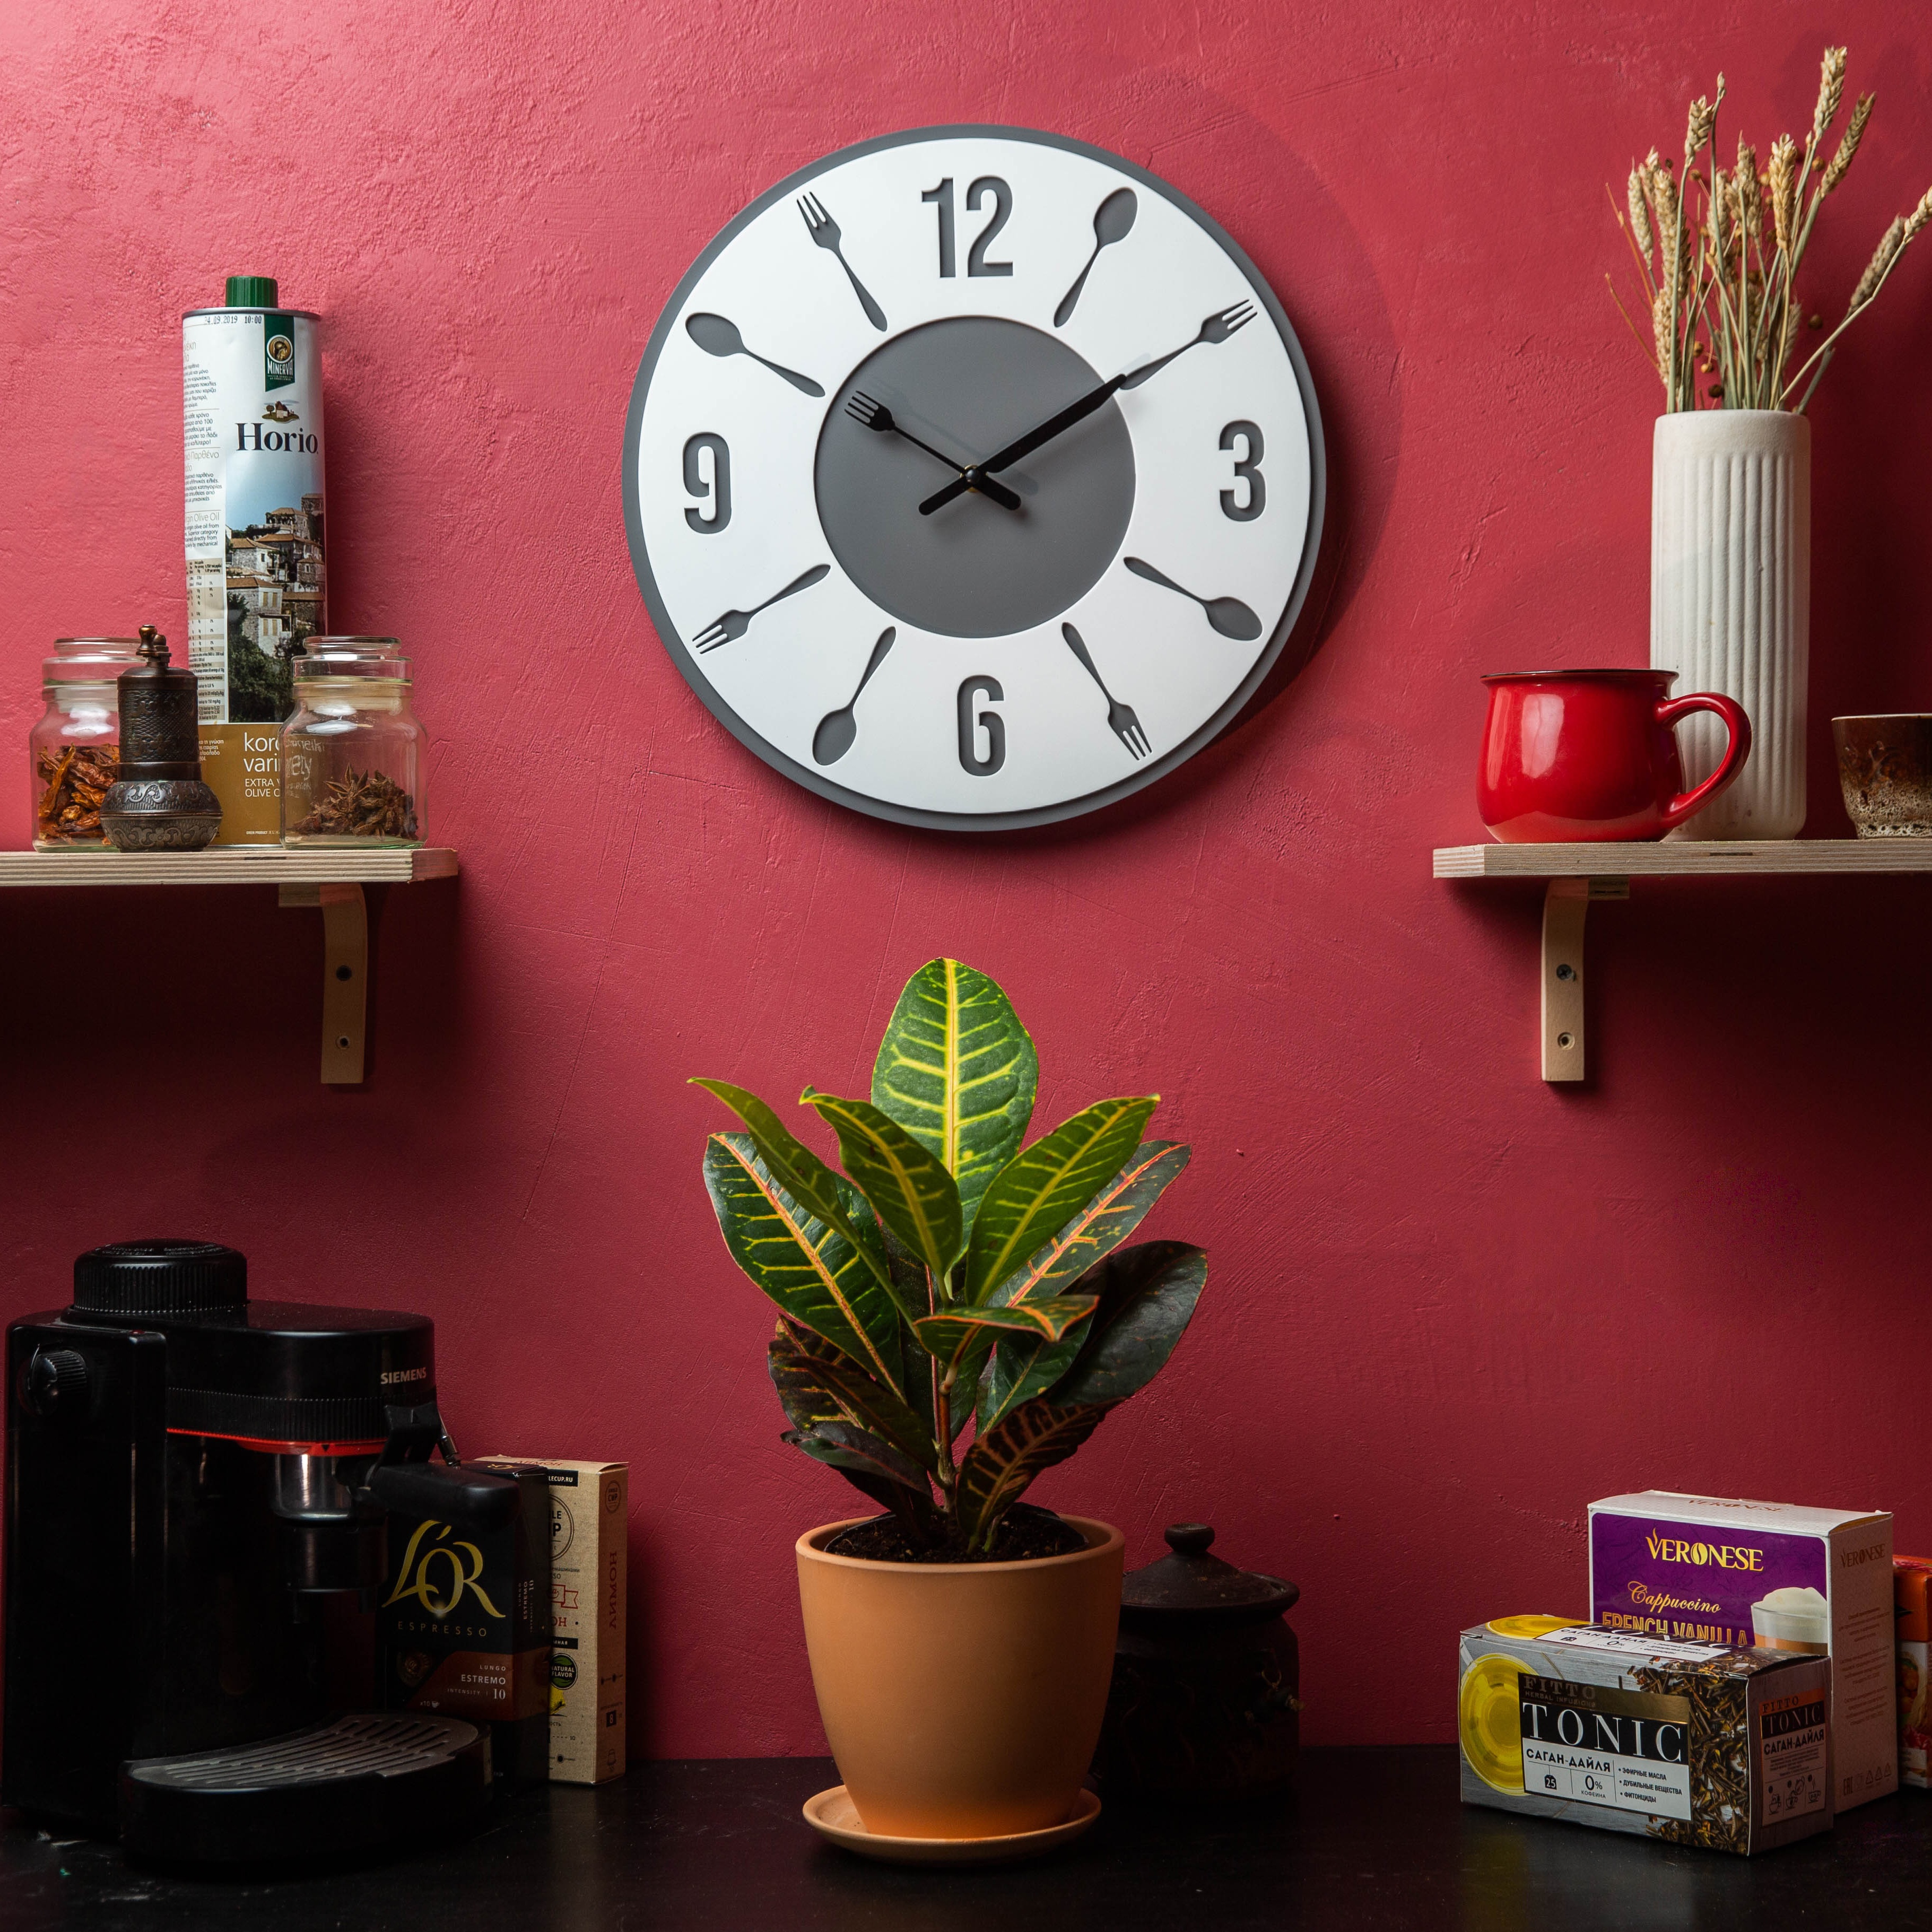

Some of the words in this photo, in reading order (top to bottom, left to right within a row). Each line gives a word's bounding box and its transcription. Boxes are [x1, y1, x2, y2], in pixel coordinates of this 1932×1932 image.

[921, 175, 1014, 279] 12
[245, 315, 262, 324] 10:00
[267, 357, 293, 376] MINERVA
[236, 423, 318, 454] Horio
[1220, 420, 1266, 521] 3
[682, 432, 732, 534] 9
[194, 513, 208, 522] Olive
[210, 511, 220, 521] Oil
[956, 676, 1006, 777] 6
[245, 778, 274, 787] EXTRA
[245, 788, 270, 797] OLIVE
[380, 1367, 427, 1385] SIEMENS
[1646, 1528, 1764, 1572] VERONESE
[1841, 1544, 1885, 1568] VERONESE
[381, 1519, 507, 1619] L'OR
[1628, 1581, 1721, 1613] Cappuccino
[398, 1621, 487, 1637] ESPRESSO
[1603, 1612, 1668, 1635] FRENCH
[461, 1674, 506, 1685] ESTREMO
[1524, 1676, 1596, 1700] FITTO
[493, 1689, 506, 1700] 10
[1526, 1690, 1553, 1701] HERBAL
[1763, 1696, 1799, 1713] FITTO
[610, 1713, 614, 1724] 8
[1765, 1704, 1821, 1735] TONIC
[1523, 1702, 1681, 1762] TONIC
[1764, 1729, 1824, 1755] САГАН-ДАЙЛЯ
[1526, 1748, 1611, 1772] САГАН-ДАЙЛЯ
[1622, 1768, 1648, 1777] ЭФИРНЫЕ
[1546, 1777, 1555, 1788] 25
[1585, 1775, 1603, 1790] 0%
[1623, 1779, 1653, 1790] ДУБИЛЬНЫЕ
[1655, 1785, 1682, 1796] ВЕЩЕСТВА
[1581, 1790, 1606, 1799] КОФЕИНА
[1624, 1792, 1656, 1803] ФИТОНЦИДЫ
